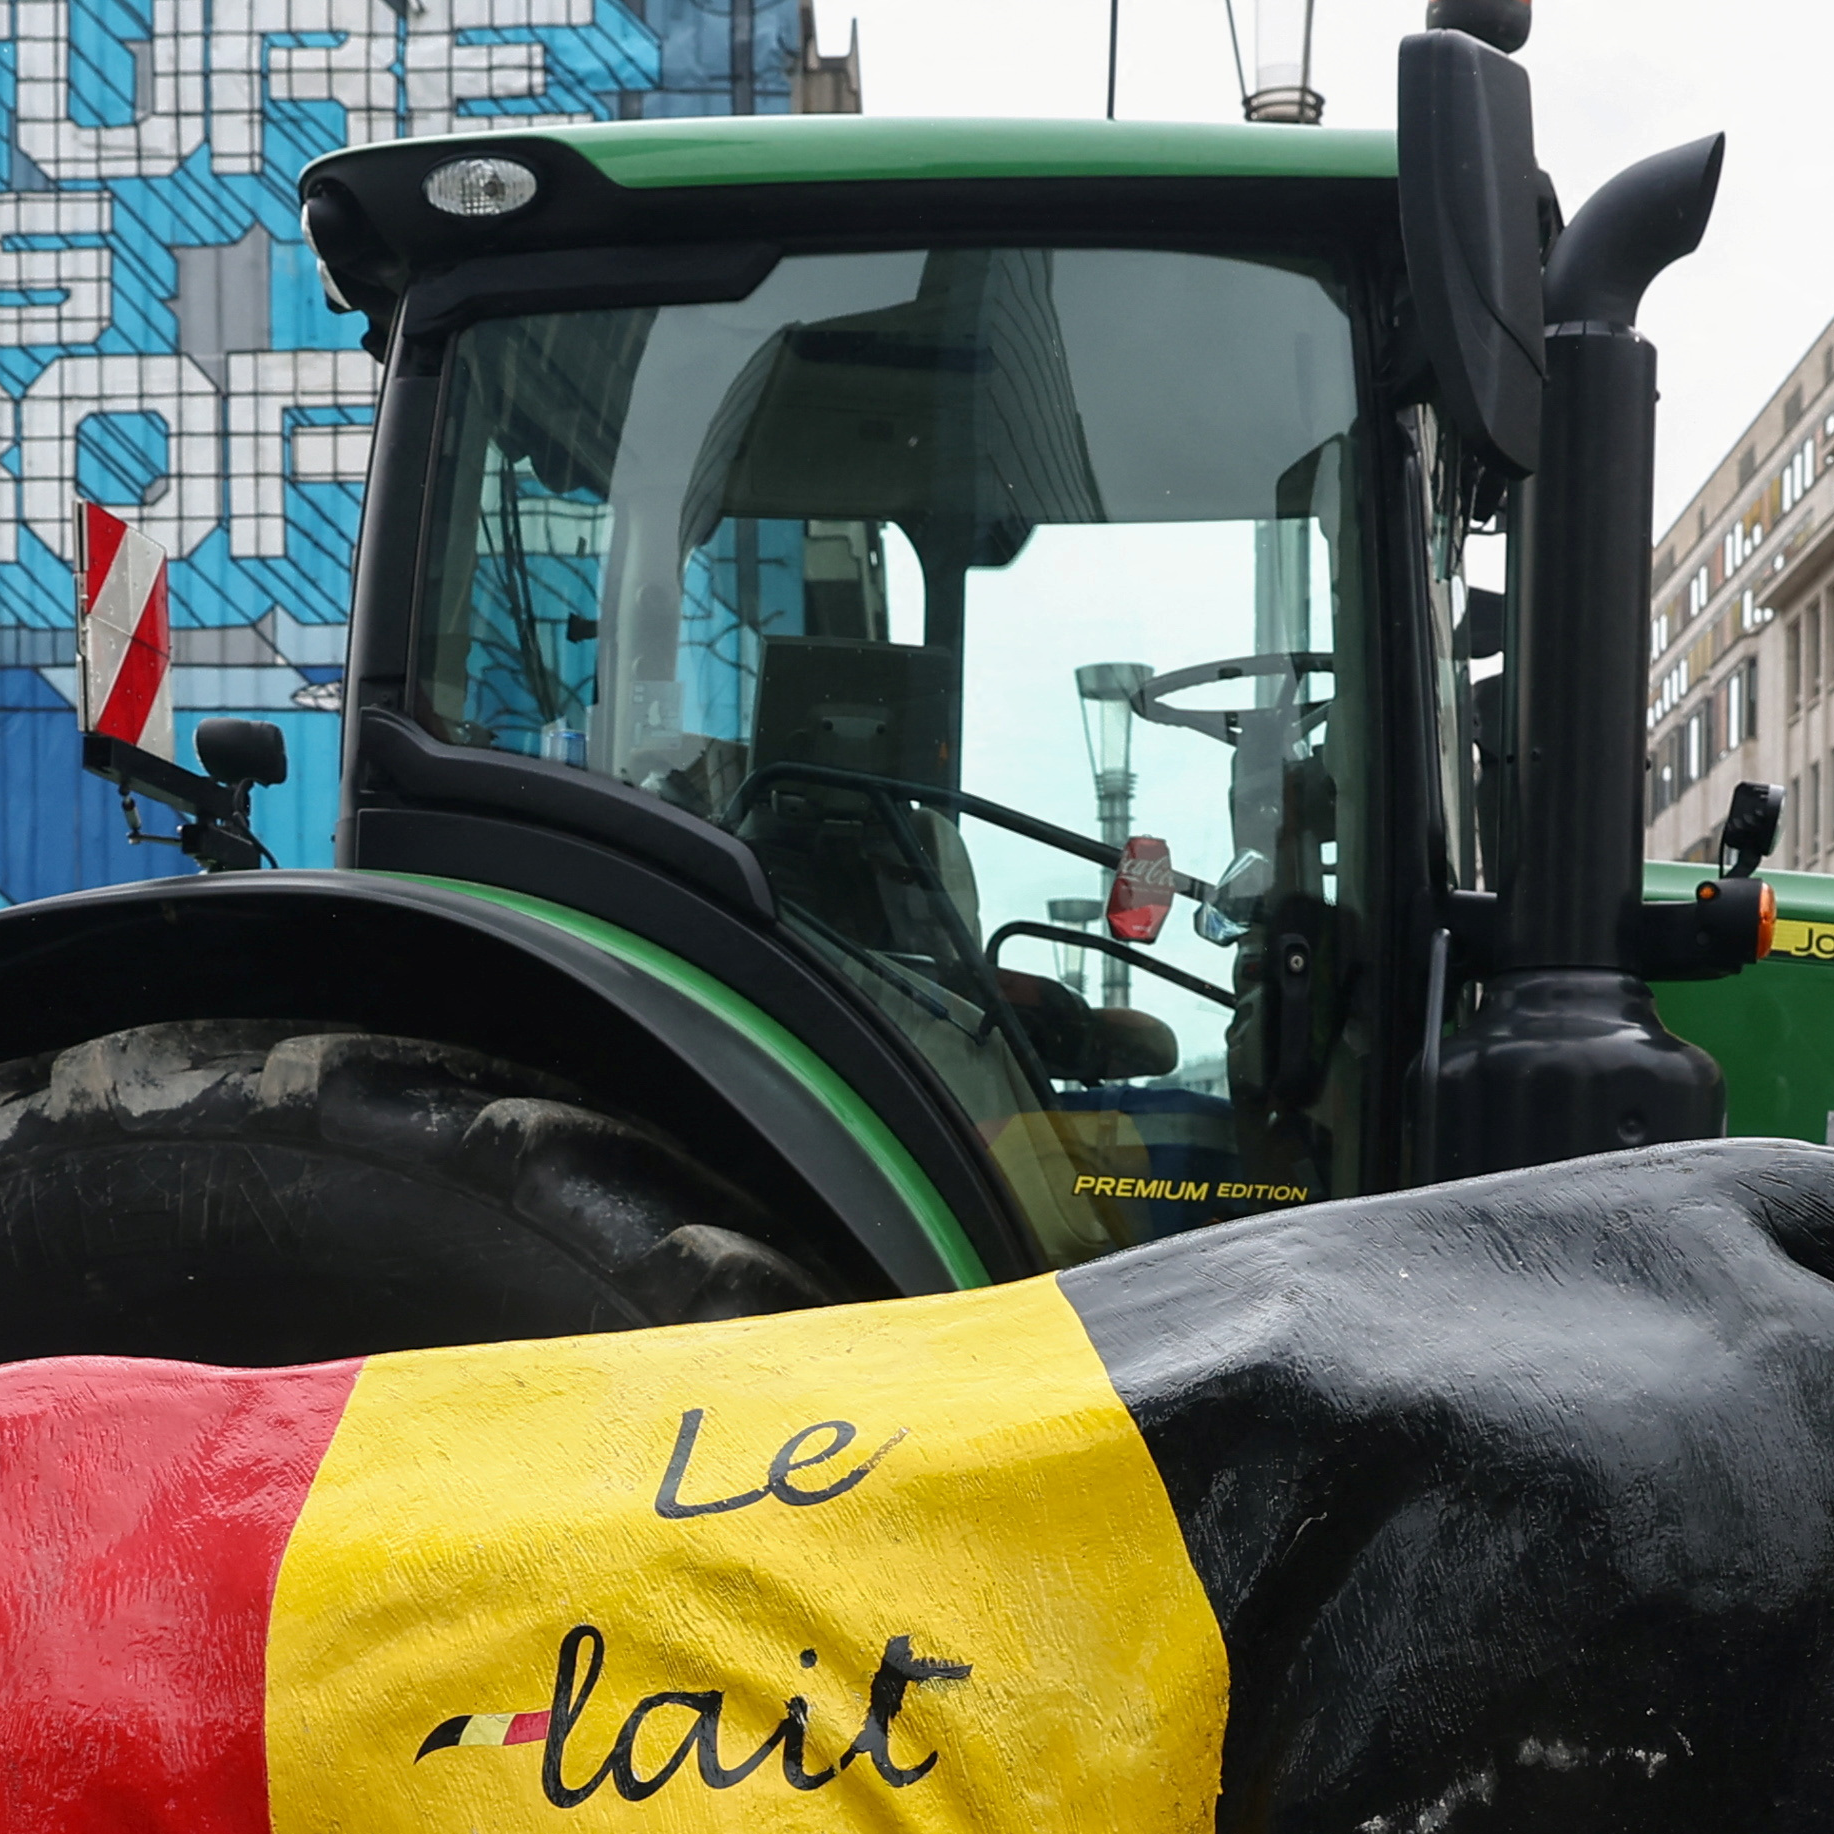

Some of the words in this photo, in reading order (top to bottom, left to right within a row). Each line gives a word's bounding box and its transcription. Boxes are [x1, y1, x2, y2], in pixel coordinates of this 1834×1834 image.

[1073, 1174, 1210, 1201] PREMIUM
[1216, 1182, 1309, 1202] EDITION
[653, 1407, 908, 1520] Le
[541, 1623, 974, 1808] lait
